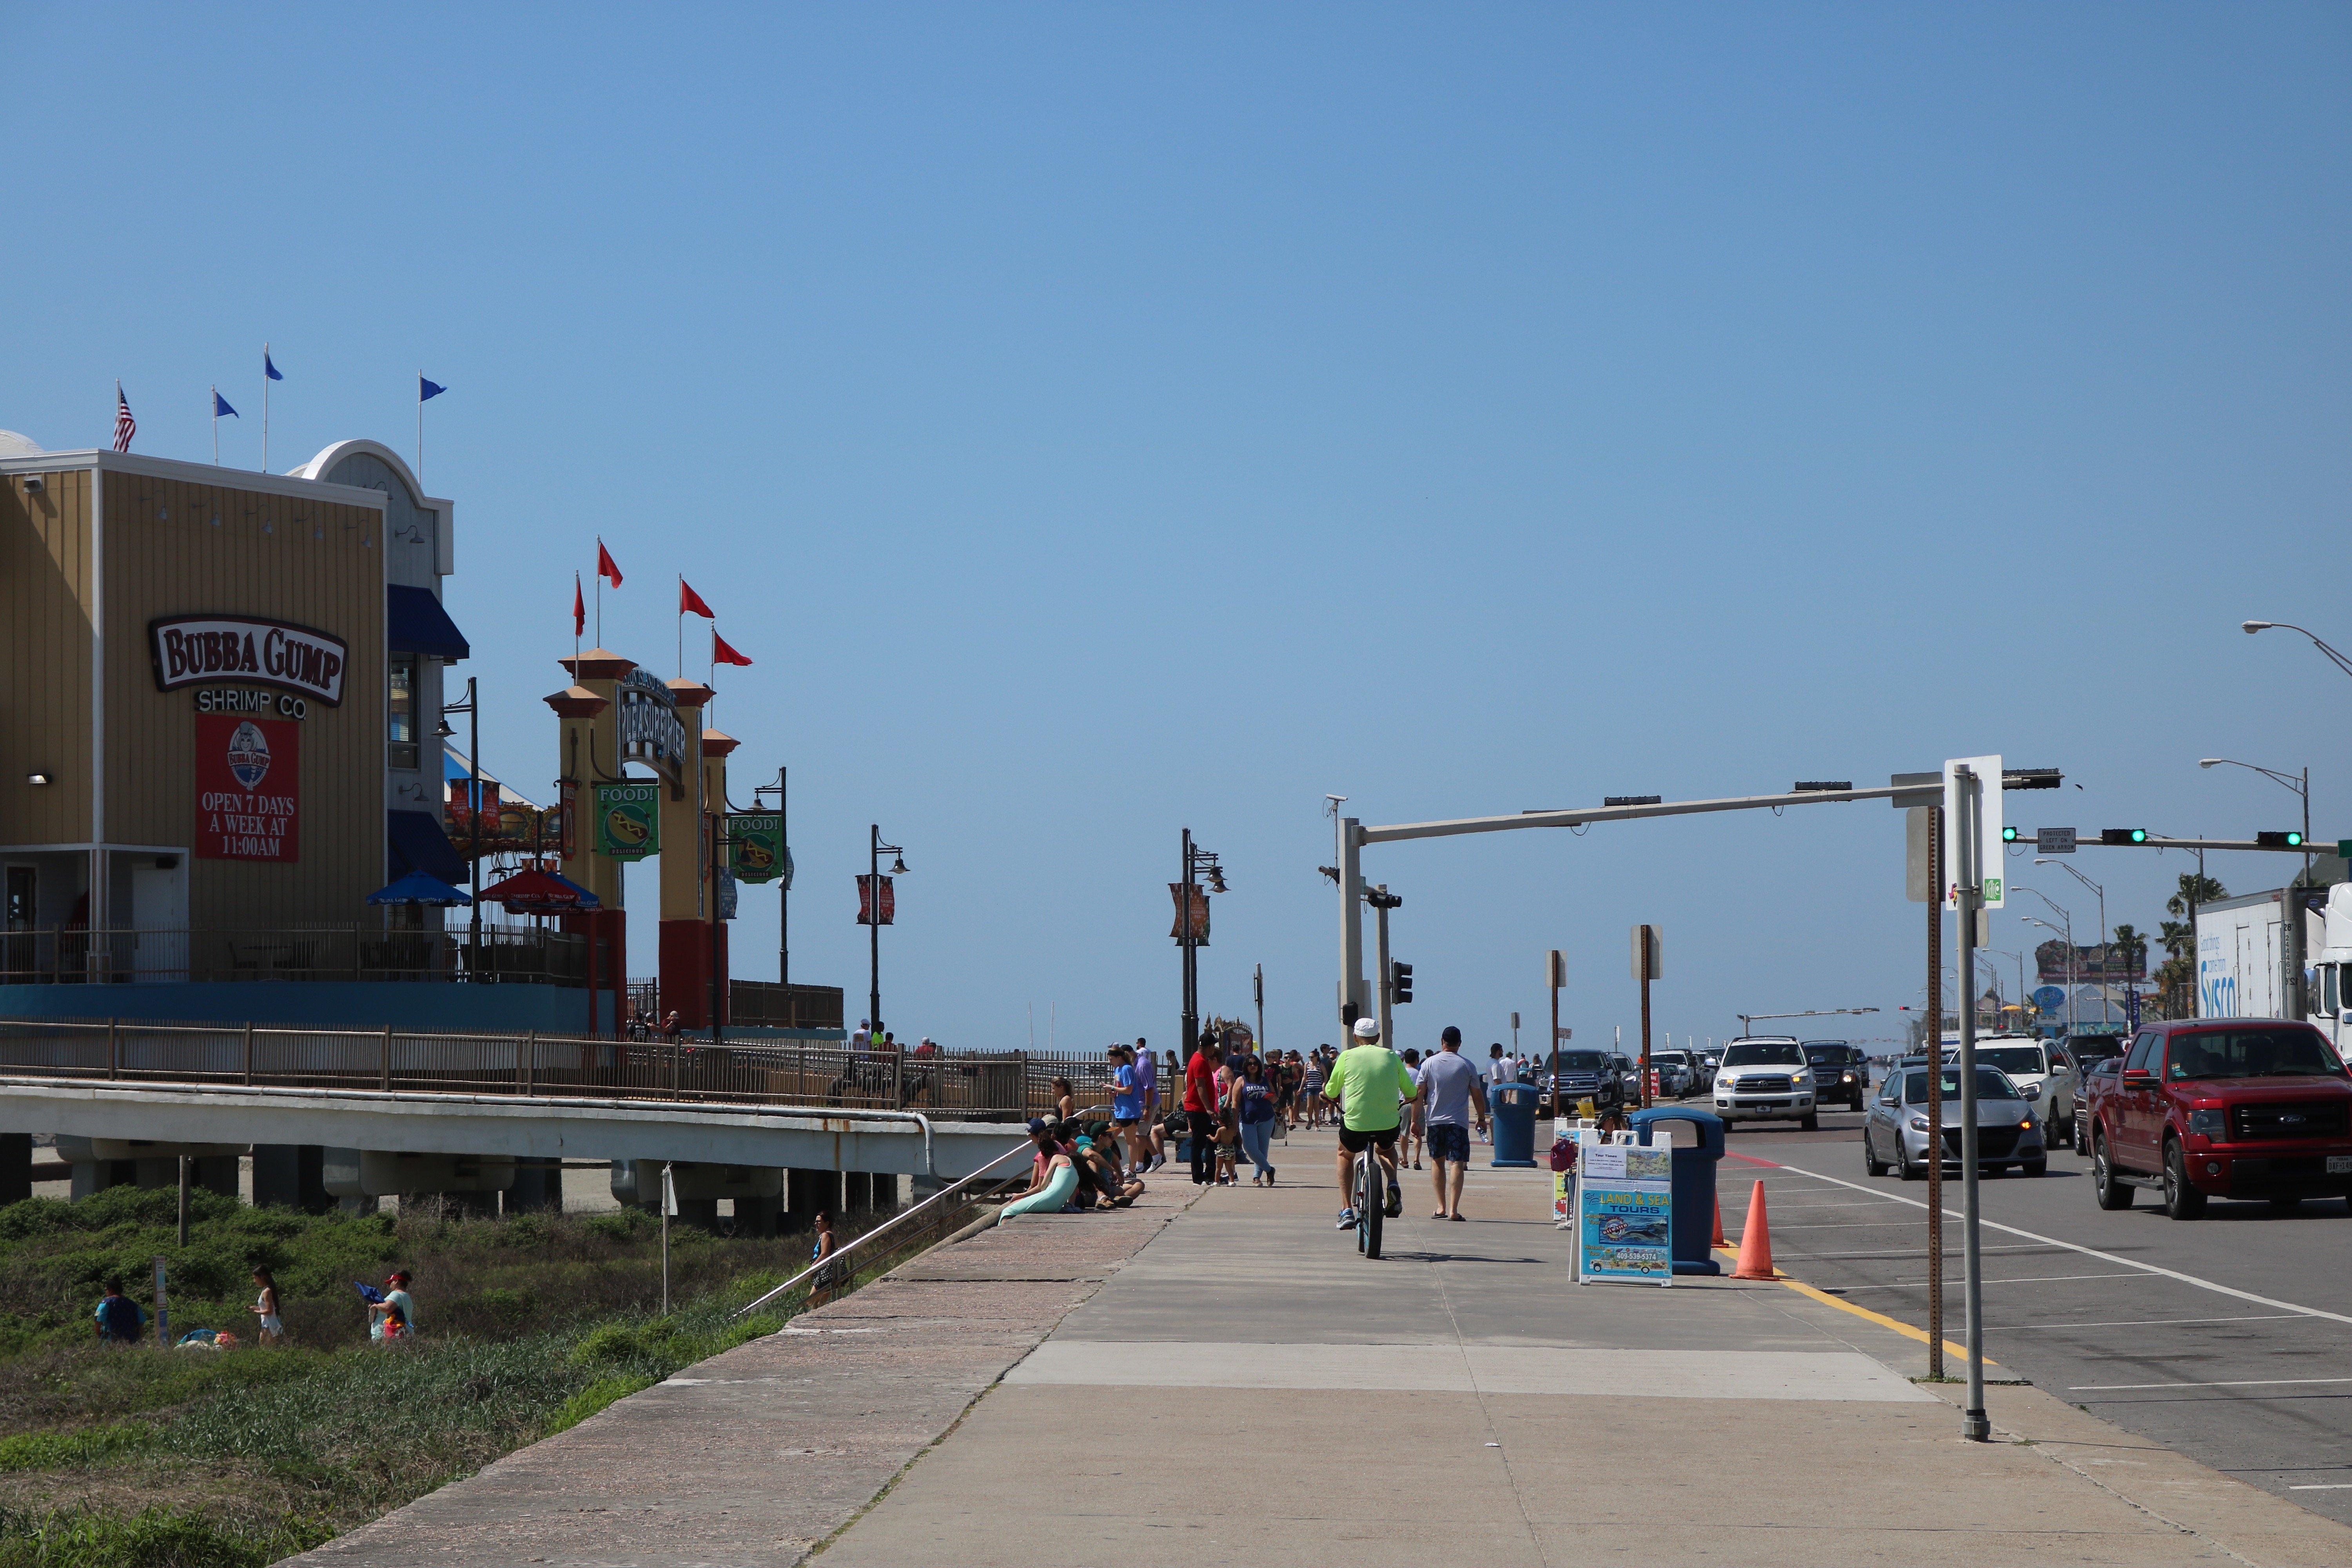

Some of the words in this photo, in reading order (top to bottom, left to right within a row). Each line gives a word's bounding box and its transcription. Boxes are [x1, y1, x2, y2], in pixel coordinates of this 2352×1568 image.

[164, 628, 260, 679] BUBBA
[264, 628, 341, 691] GUMP
[199, 690, 271, 712] SHRIMP
[622, 704, 666, 745] PLEASURE
[667, 707, 686, 763] PIER
[229, 752, 250, 765] BUBBA
[251, 752, 270, 768] GUMP
[202, 792, 242, 813] OPEN
[246, 795, 254, 813] 7
[258, 795, 294, 816] DAYS
[600, 788, 654, 802] FOOD!
[209, 813, 220, 832] A
[225, 814, 266, 835] WEEK
[270, 817, 287, 836] AT
[731, 819, 779, 830] FOOD!
[222, 835, 280, 857] 11:00AM
[1600, 1193, 1632, 1205] LAND
[1635, 1194, 1645, 1205] &
[1648, 1195, 1670, 1207] SEA
[1610, 1205, 1660, 1214] TOURS
